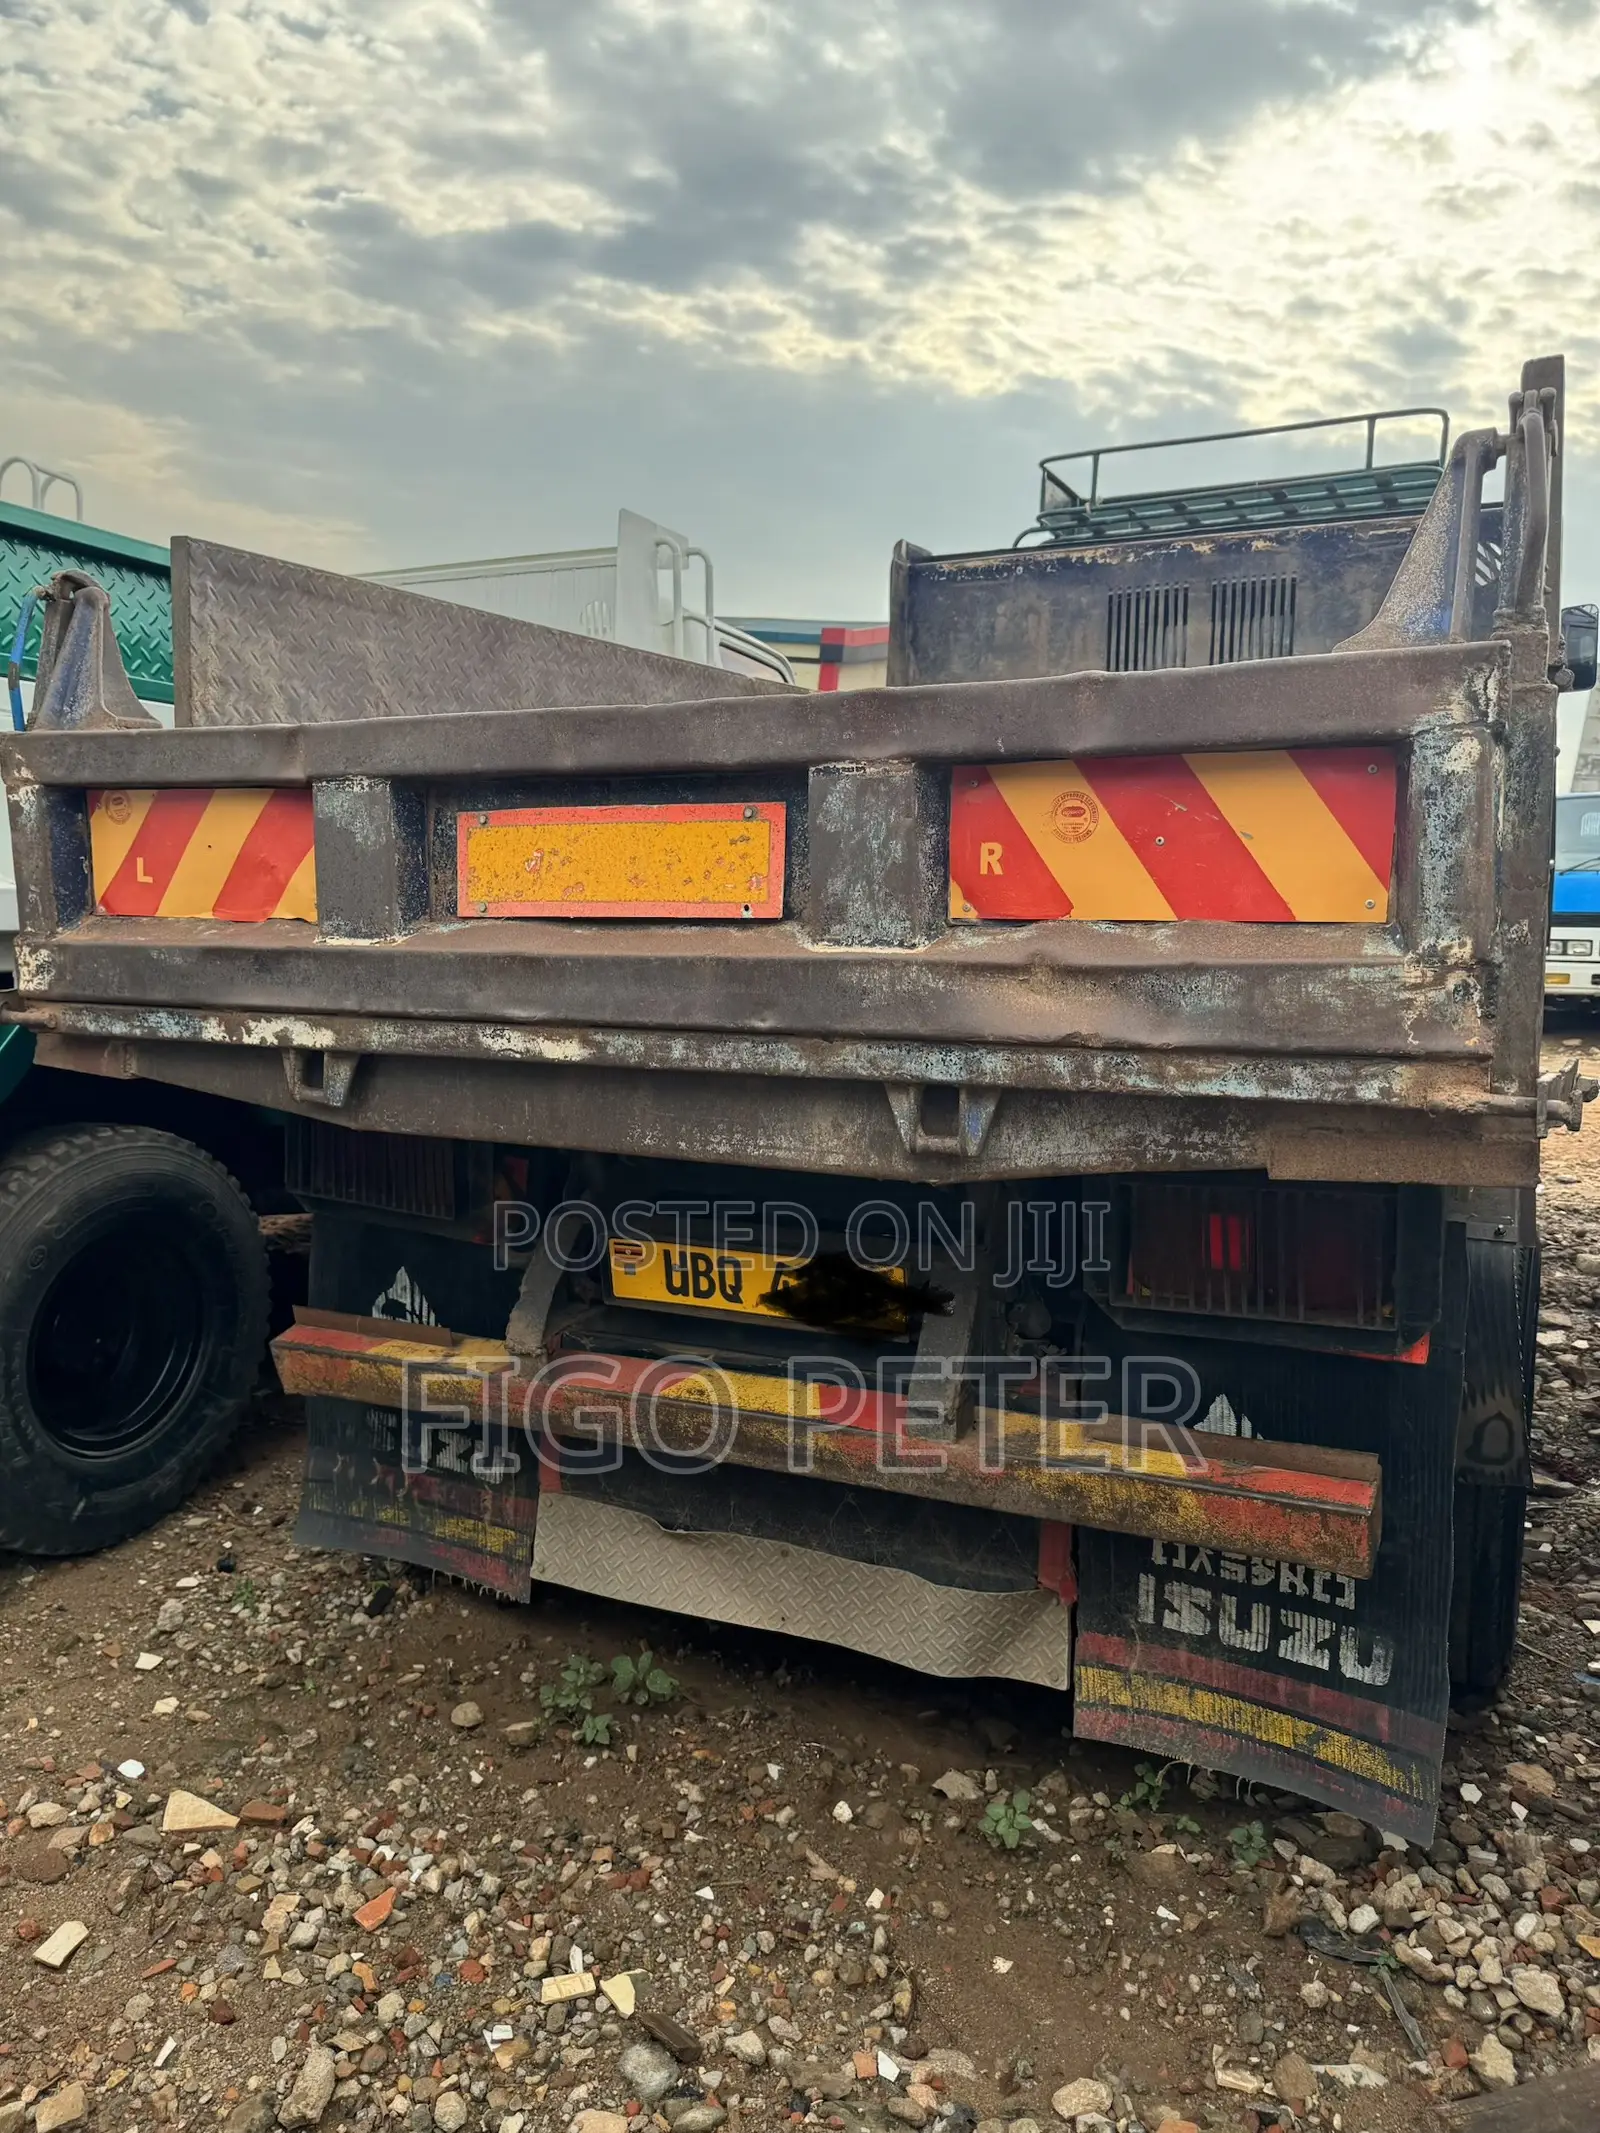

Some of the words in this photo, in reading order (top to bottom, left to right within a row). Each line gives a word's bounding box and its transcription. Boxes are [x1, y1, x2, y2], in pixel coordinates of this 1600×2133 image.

[136, 856, 153, 883] L
[979, 842, 1003, 875] R
[663, 1248, 744, 1305] UBQ
[1137, 1572, 1395, 1686] ISUZU
